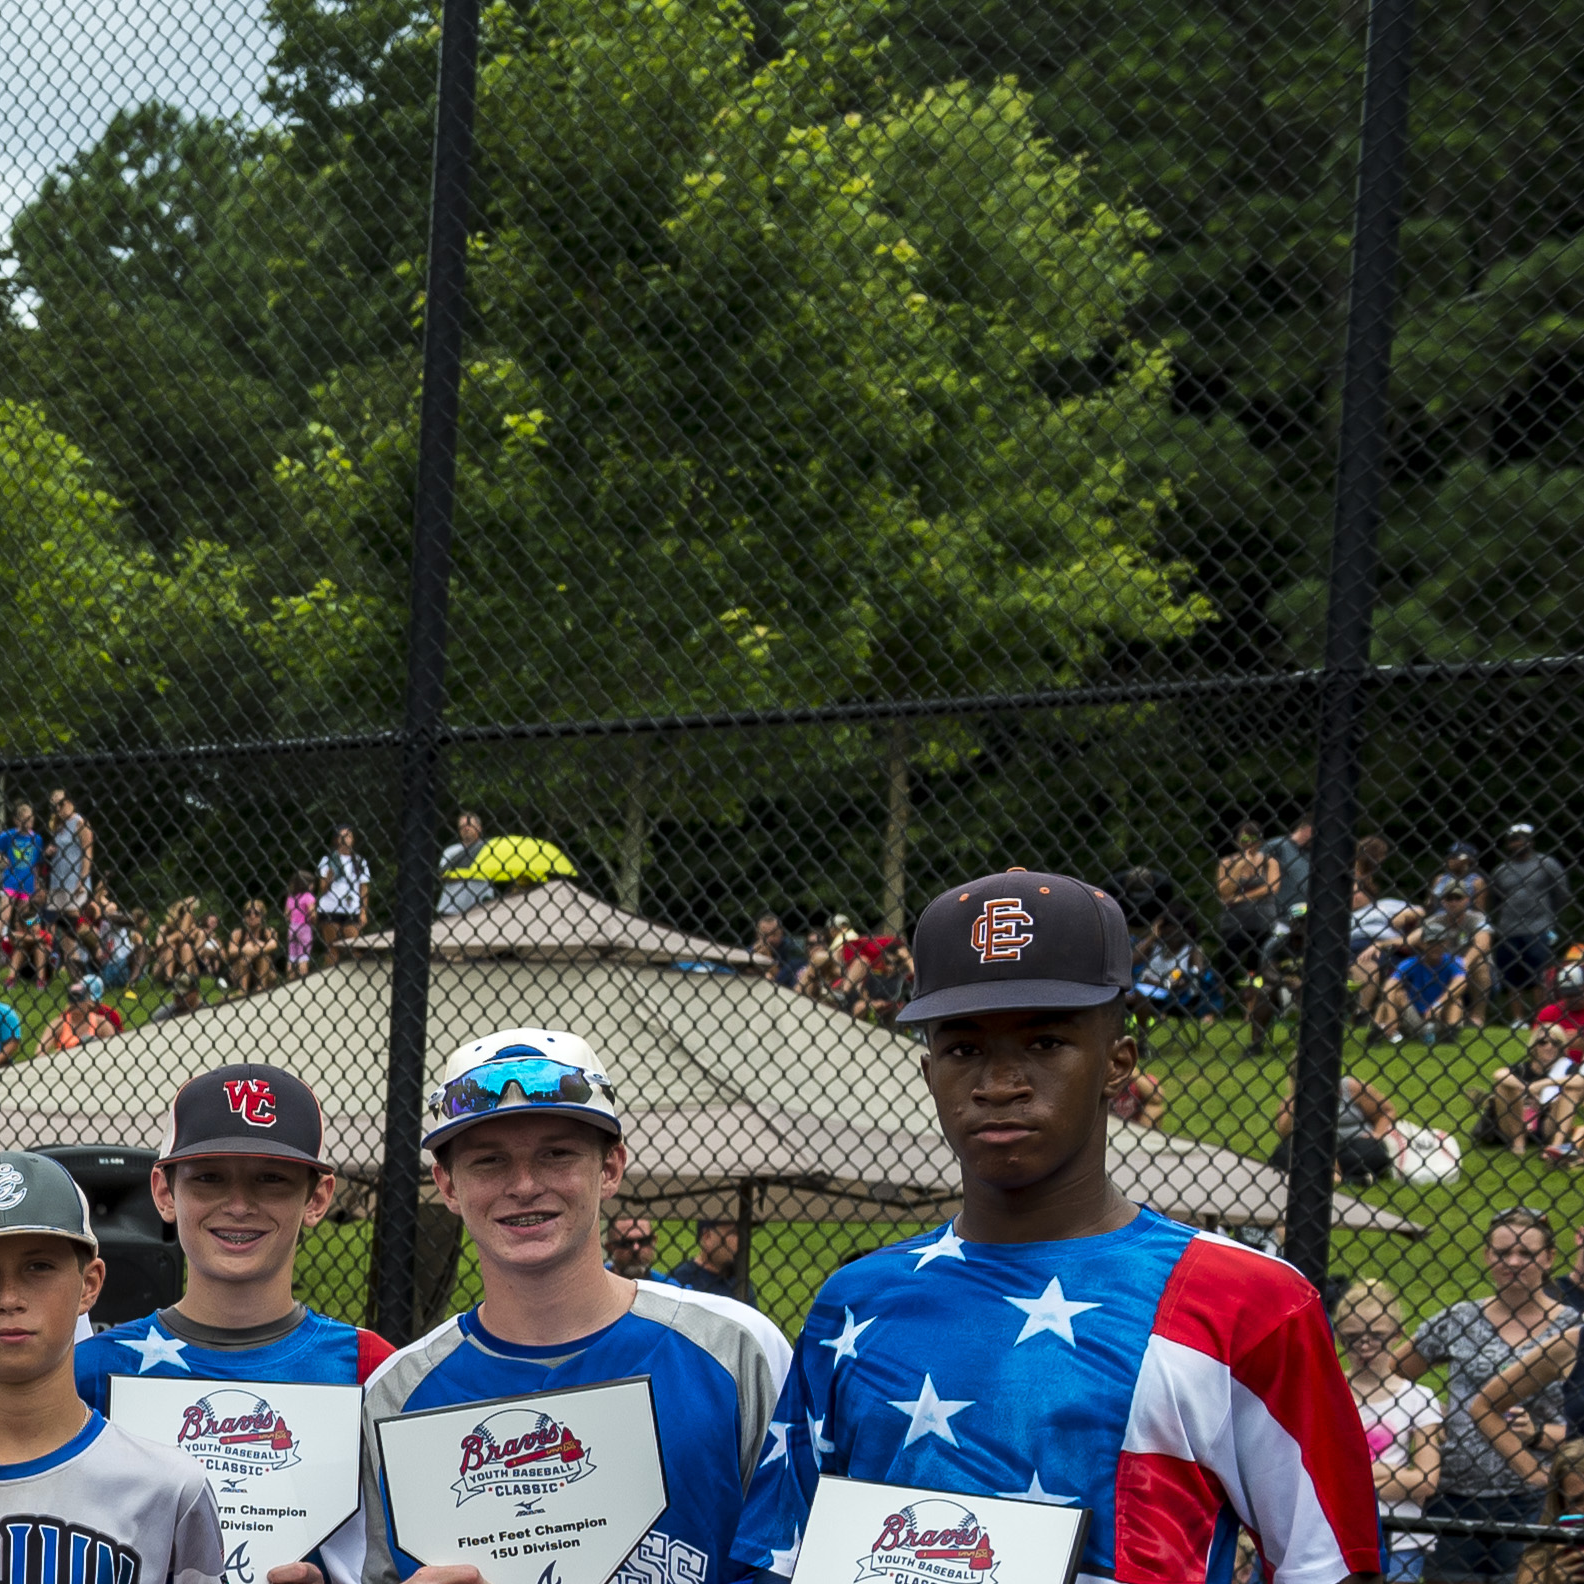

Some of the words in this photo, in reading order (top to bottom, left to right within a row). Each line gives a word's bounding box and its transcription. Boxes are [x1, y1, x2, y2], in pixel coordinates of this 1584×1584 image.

[178, 1405, 273, 1443] Braves
[460, 1422, 559, 1476] Braves
[221, 1520, 273, 1532] Division
[240, 1505, 307, 1518] Champion
[457, 1534, 495, 1548] Fleet
[499, 1528, 531, 1542] Feet
[535, 1516, 607, 1536] Champion
[490, 1546, 518, 1559] 15U
[523, 1537, 580, 1555] Division
[871, 1514, 980, 1553] Braves
